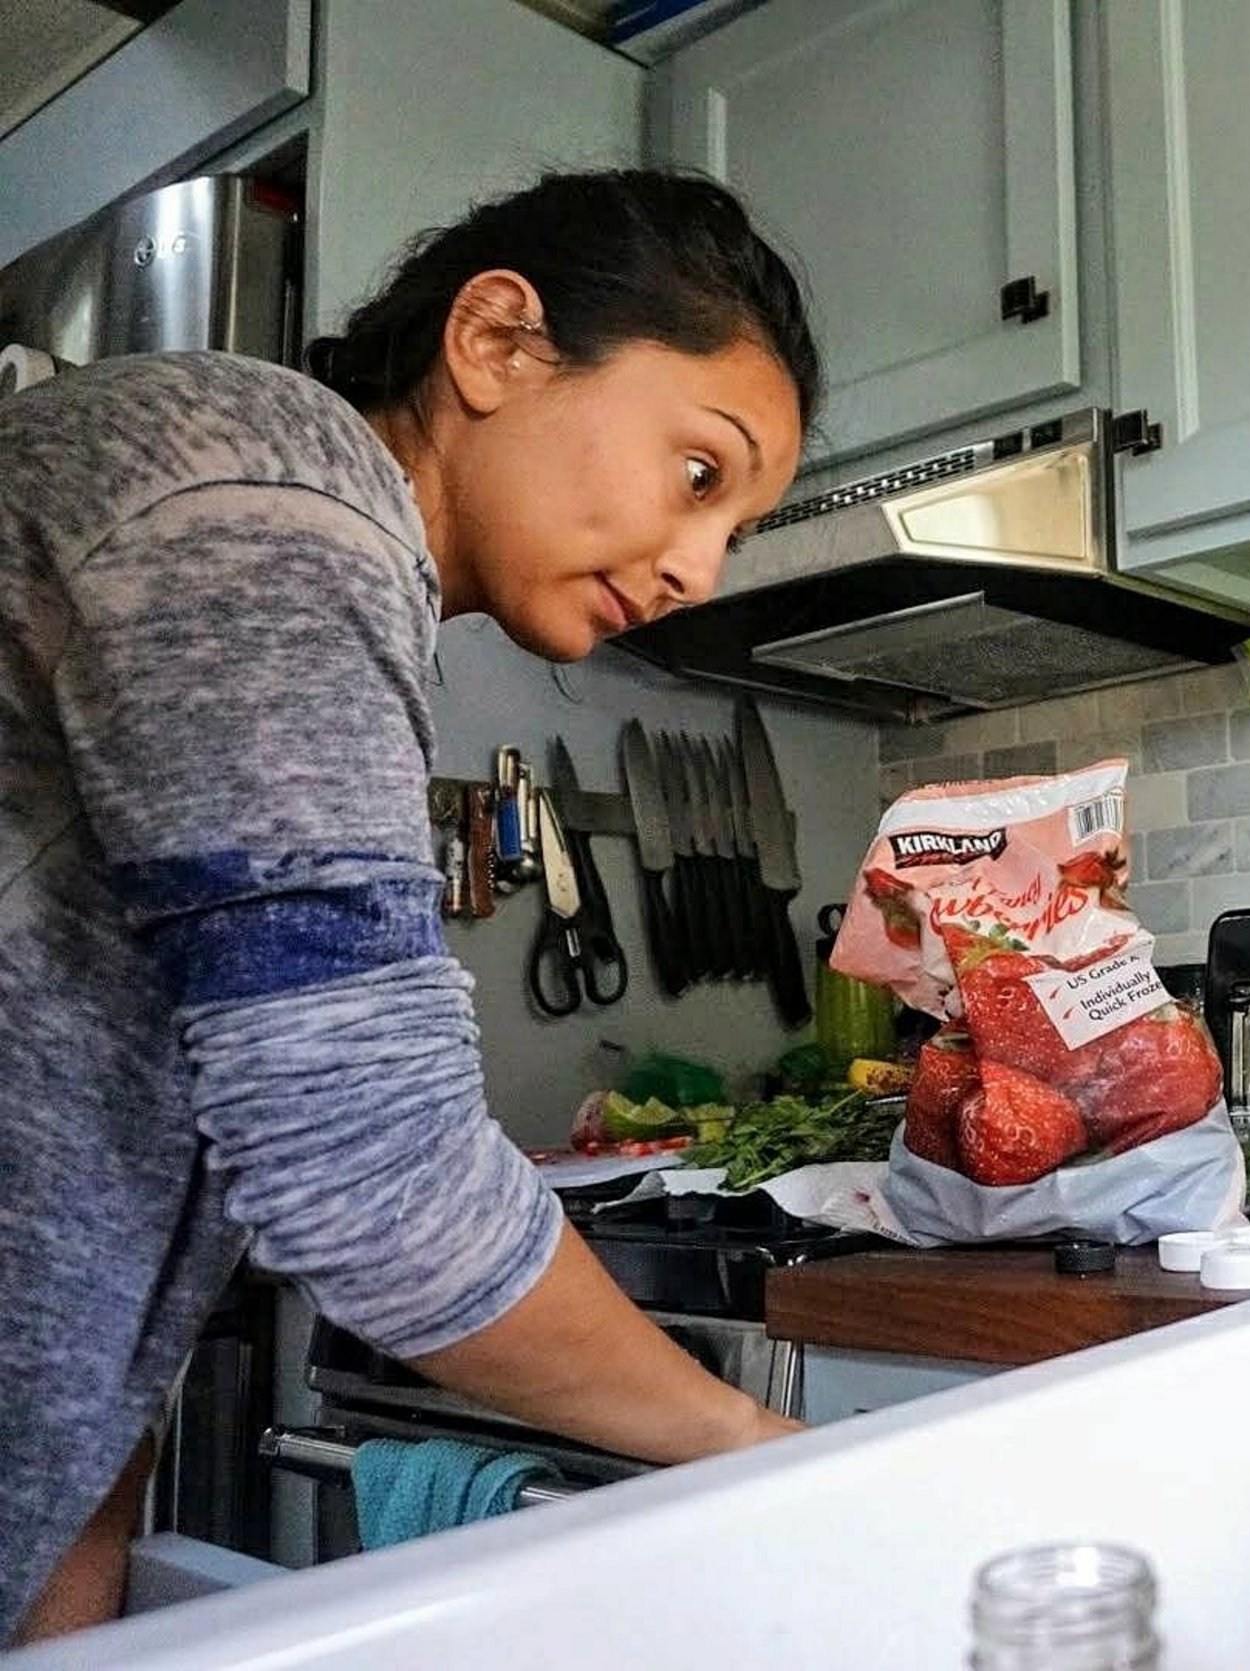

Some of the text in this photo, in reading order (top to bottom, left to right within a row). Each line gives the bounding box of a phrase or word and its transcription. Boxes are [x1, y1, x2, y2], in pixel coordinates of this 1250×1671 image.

[897, 832, 1002, 855] KIRKLAND
[1066, 974, 1088, 990] US
[1088, 958, 1128, 980] Grade
[1080, 971, 1151, 1010] Individually
[1088, 998, 1127, 1020] Quick
